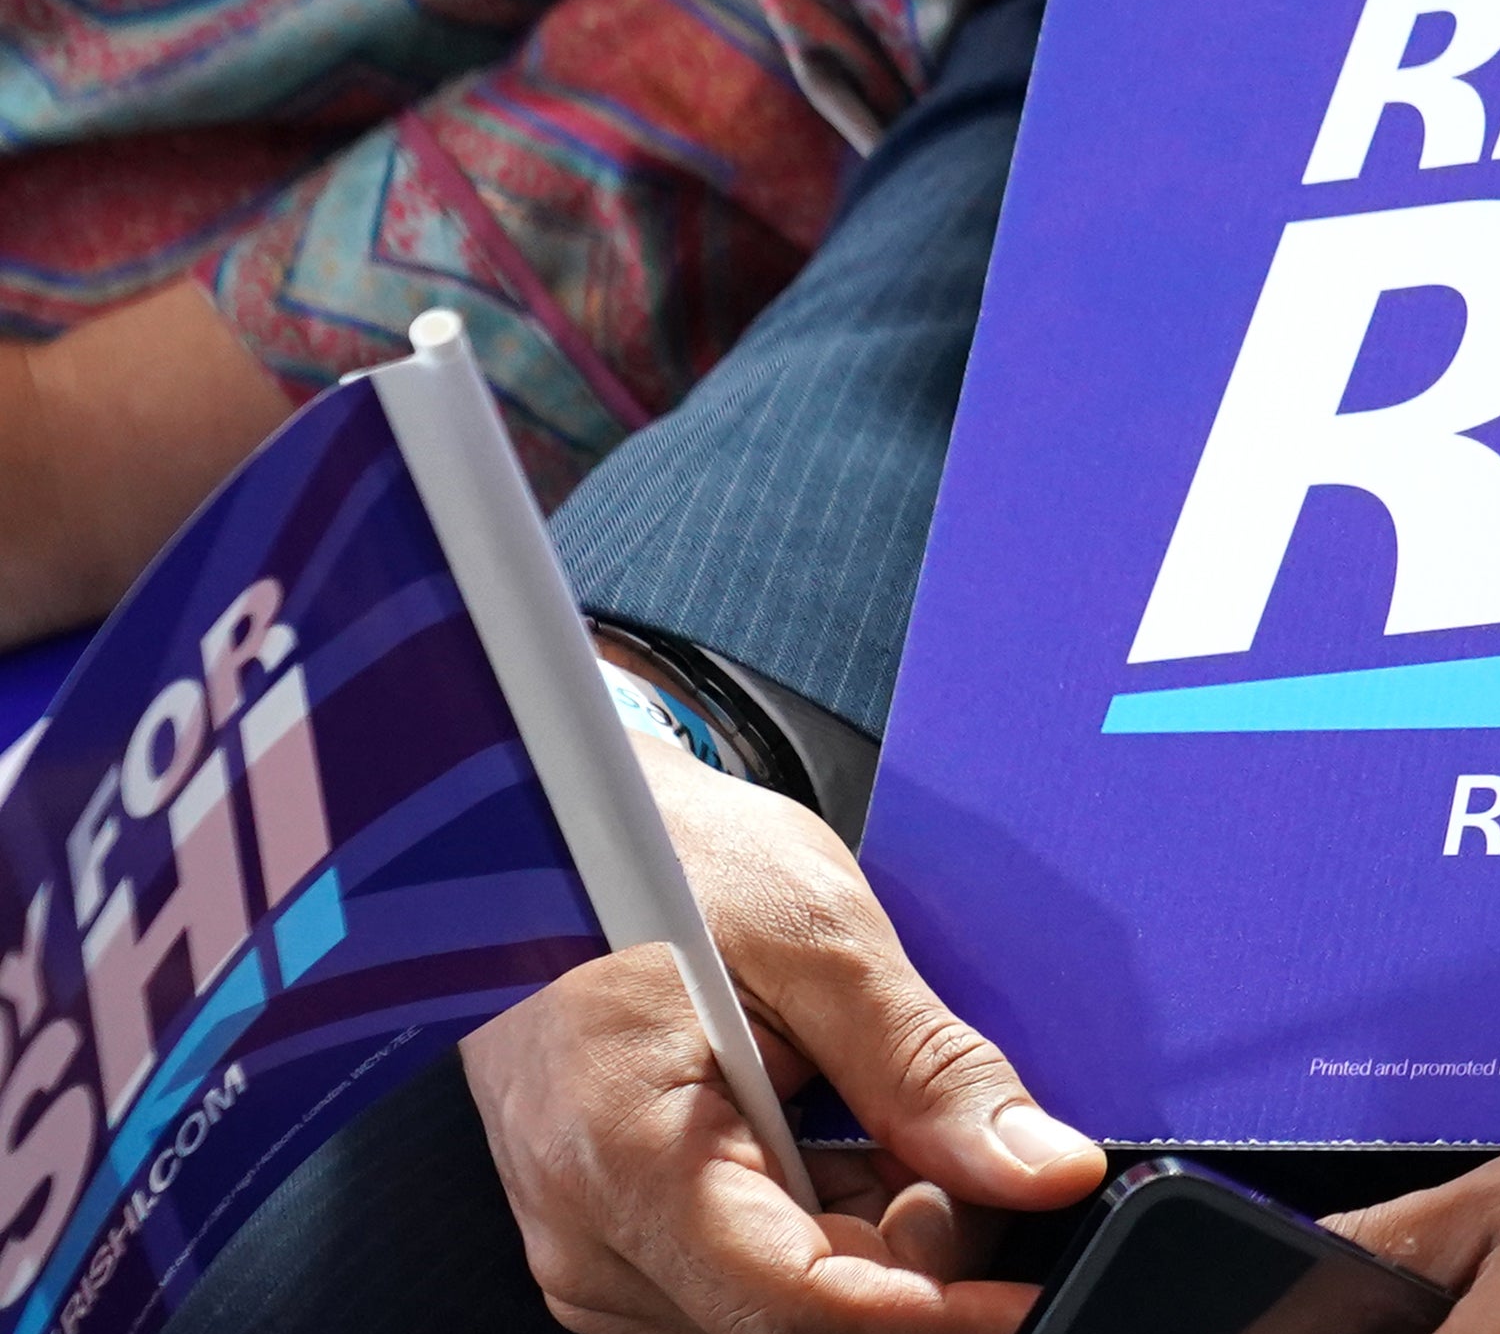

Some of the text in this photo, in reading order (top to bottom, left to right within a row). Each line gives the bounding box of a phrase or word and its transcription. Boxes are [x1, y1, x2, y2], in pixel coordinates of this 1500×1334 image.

[66, 578, 298, 929] FOR
[1309, 1058, 1373, 1076] Printed
[1375, 1058, 1411, 1076] and
[1409, 1058, 1497, 1080] promoted
